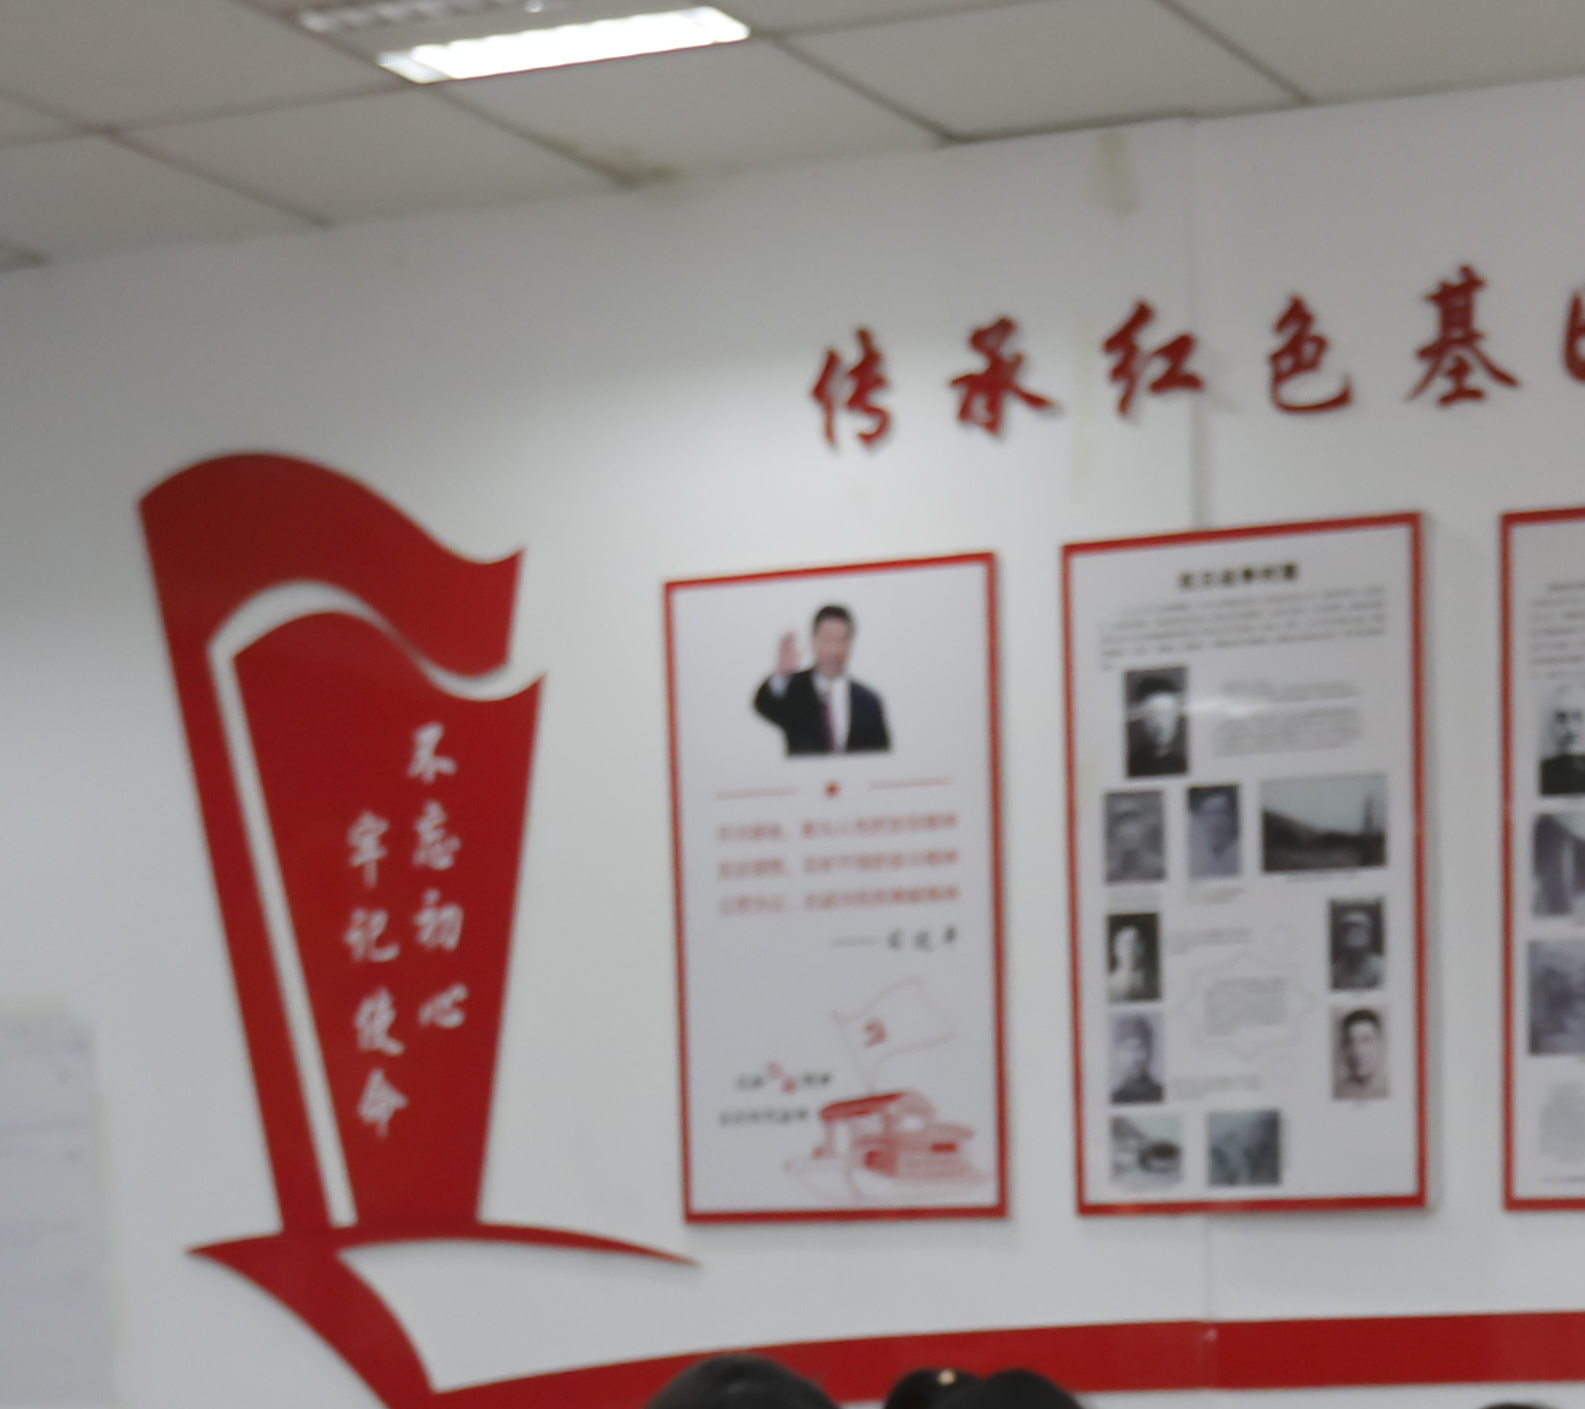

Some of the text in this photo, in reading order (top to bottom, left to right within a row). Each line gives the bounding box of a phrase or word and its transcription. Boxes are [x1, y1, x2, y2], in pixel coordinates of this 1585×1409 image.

[343, 810, 409, 1140] 牢记使命
[406, 721, 469, 1032] 不忘初心
